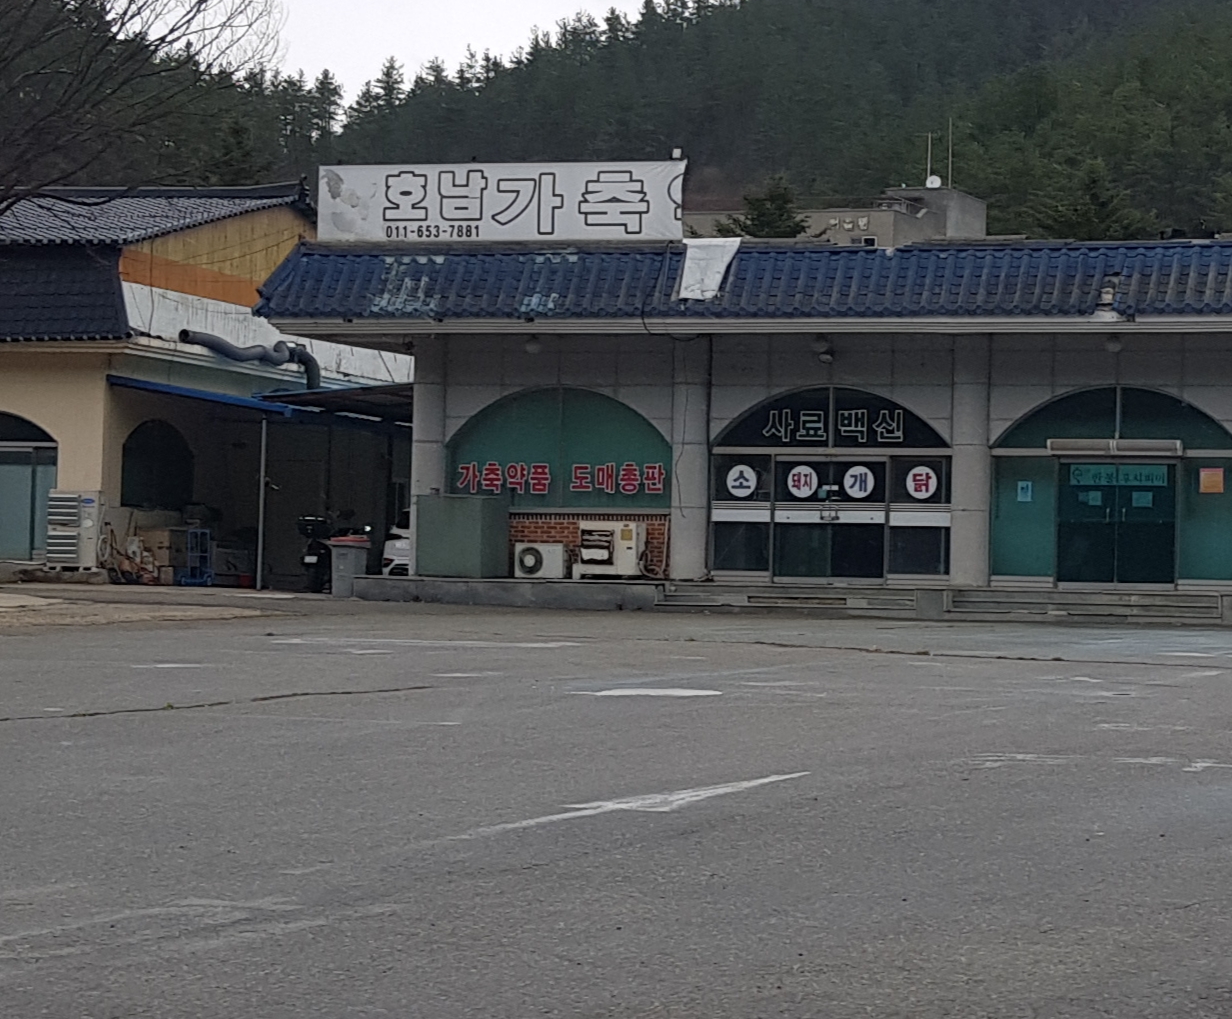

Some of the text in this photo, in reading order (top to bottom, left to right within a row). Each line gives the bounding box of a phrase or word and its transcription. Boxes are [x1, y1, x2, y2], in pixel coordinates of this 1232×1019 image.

[385, 224, 480, 239] 011-653-7881
[457, 462, 665, 494] 가축약품 도매총판
[730, 470, 933, 493] 소 돼지 개 닭
